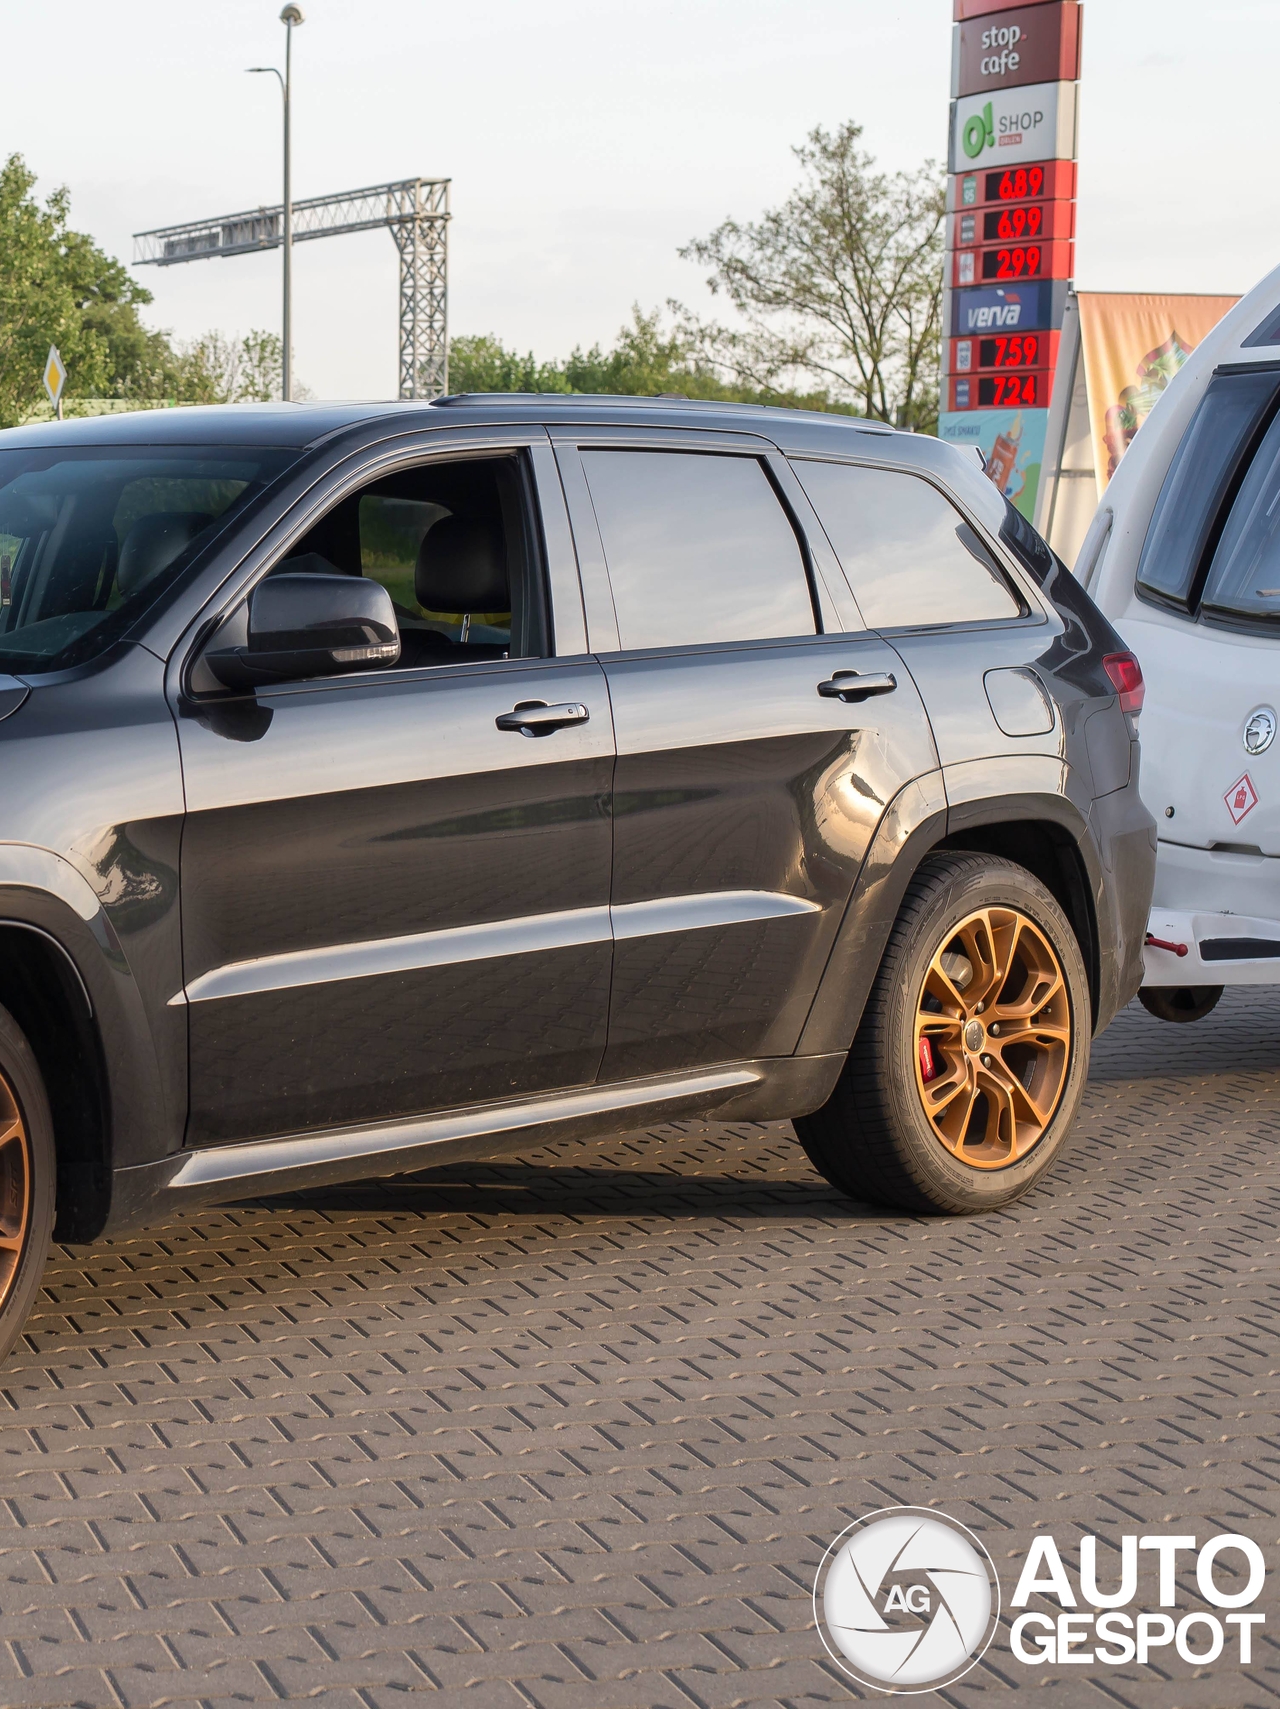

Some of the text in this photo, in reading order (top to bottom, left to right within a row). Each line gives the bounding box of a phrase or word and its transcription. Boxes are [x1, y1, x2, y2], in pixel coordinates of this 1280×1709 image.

[980, 50, 1020, 75] cafe
[998, 111, 1044, 134] SHOP
[968, 304, 1021, 328] verva
